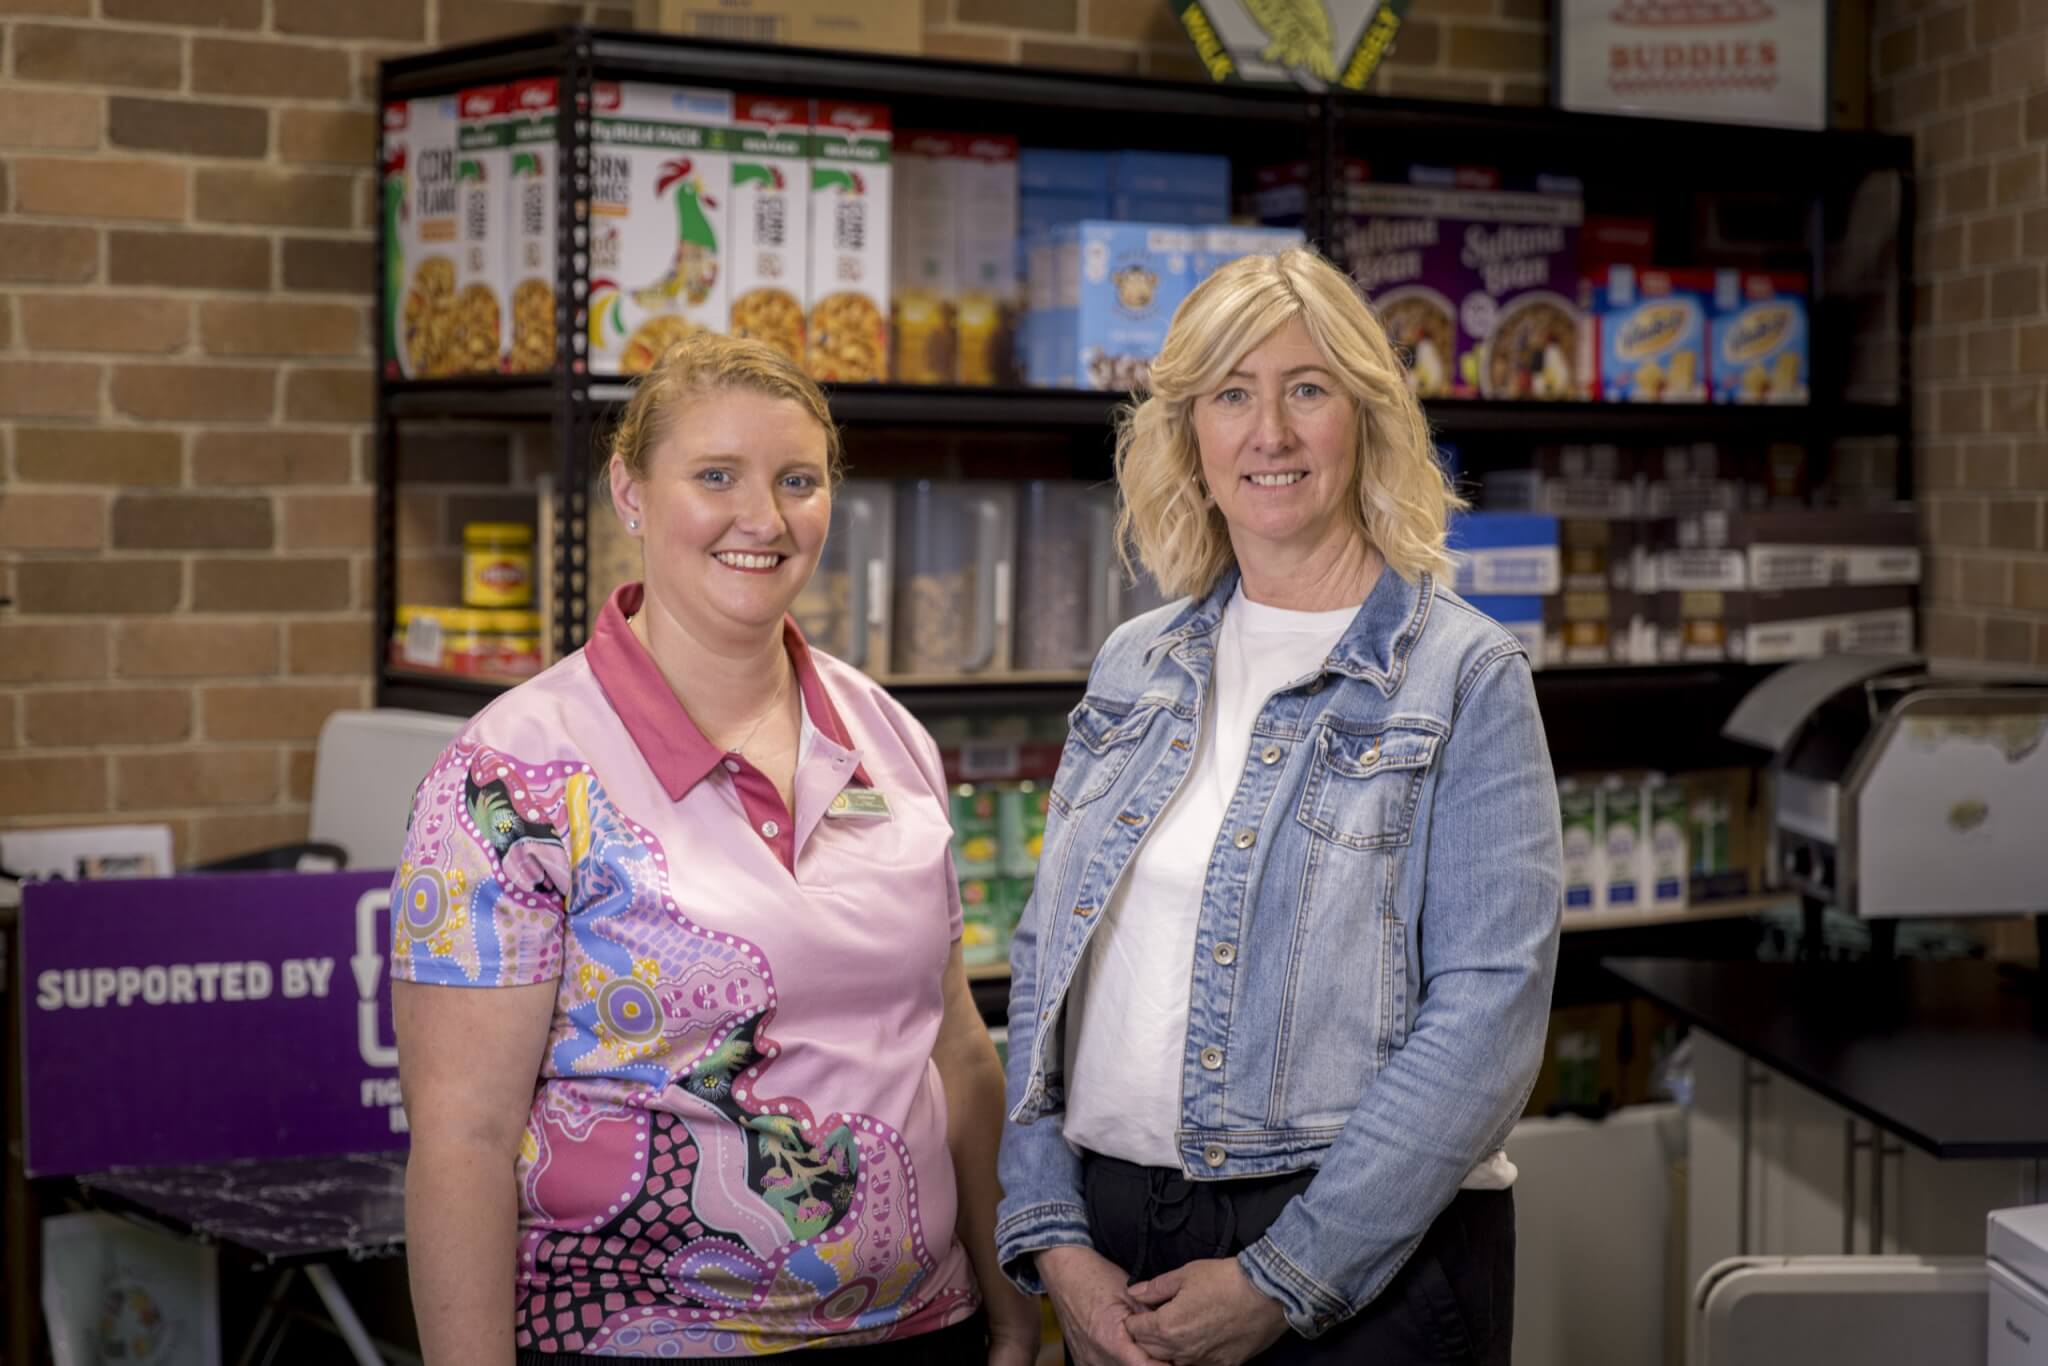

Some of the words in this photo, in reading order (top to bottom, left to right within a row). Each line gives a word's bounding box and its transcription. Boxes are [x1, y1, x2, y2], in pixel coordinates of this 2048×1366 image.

[1608, 42, 1779, 70] BUDDIES
[656, 126, 699, 145] PACK
[416, 150, 453, 182] COR
[590, 157, 629, 179] ORN
[590, 181, 629, 201] AKES
[1461, 223, 1567, 269] Sultana
[37, 961, 273, 1010] SUPPORTED
[282, 958, 334, 998] BY
[361, 1079, 403, 1107] FIG
